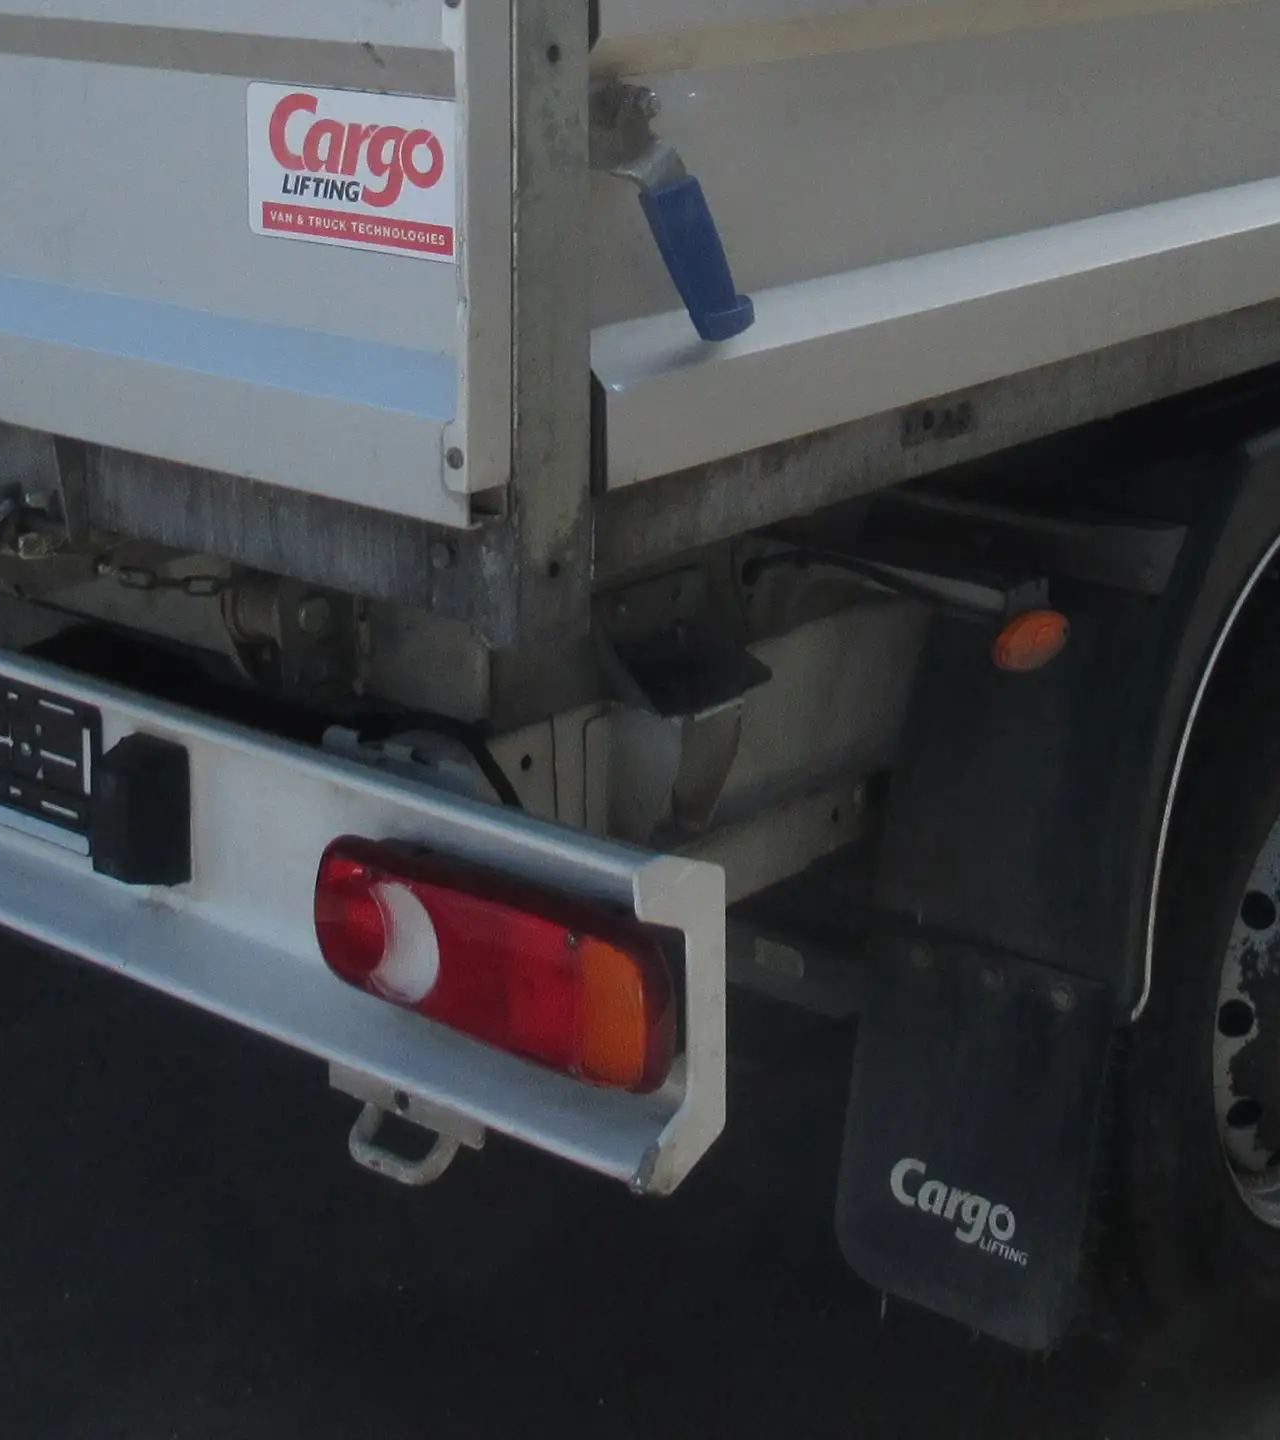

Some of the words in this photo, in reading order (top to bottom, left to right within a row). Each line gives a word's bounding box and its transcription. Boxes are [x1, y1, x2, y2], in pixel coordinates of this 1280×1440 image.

[268, 92, 444, 208] Cargo
[281, 172, 361, 203] LIFTING
[270, 210, 293, 224] VAN
[296, 214, 305, 226] &
[308, 216, 347, 232] TRUCK
[351, 222, 446, 247] TECHNOLOGIES
[890, 1158, 1016, 1244] Cargo
[978, 1236, 1029, 1266] LIFTING
